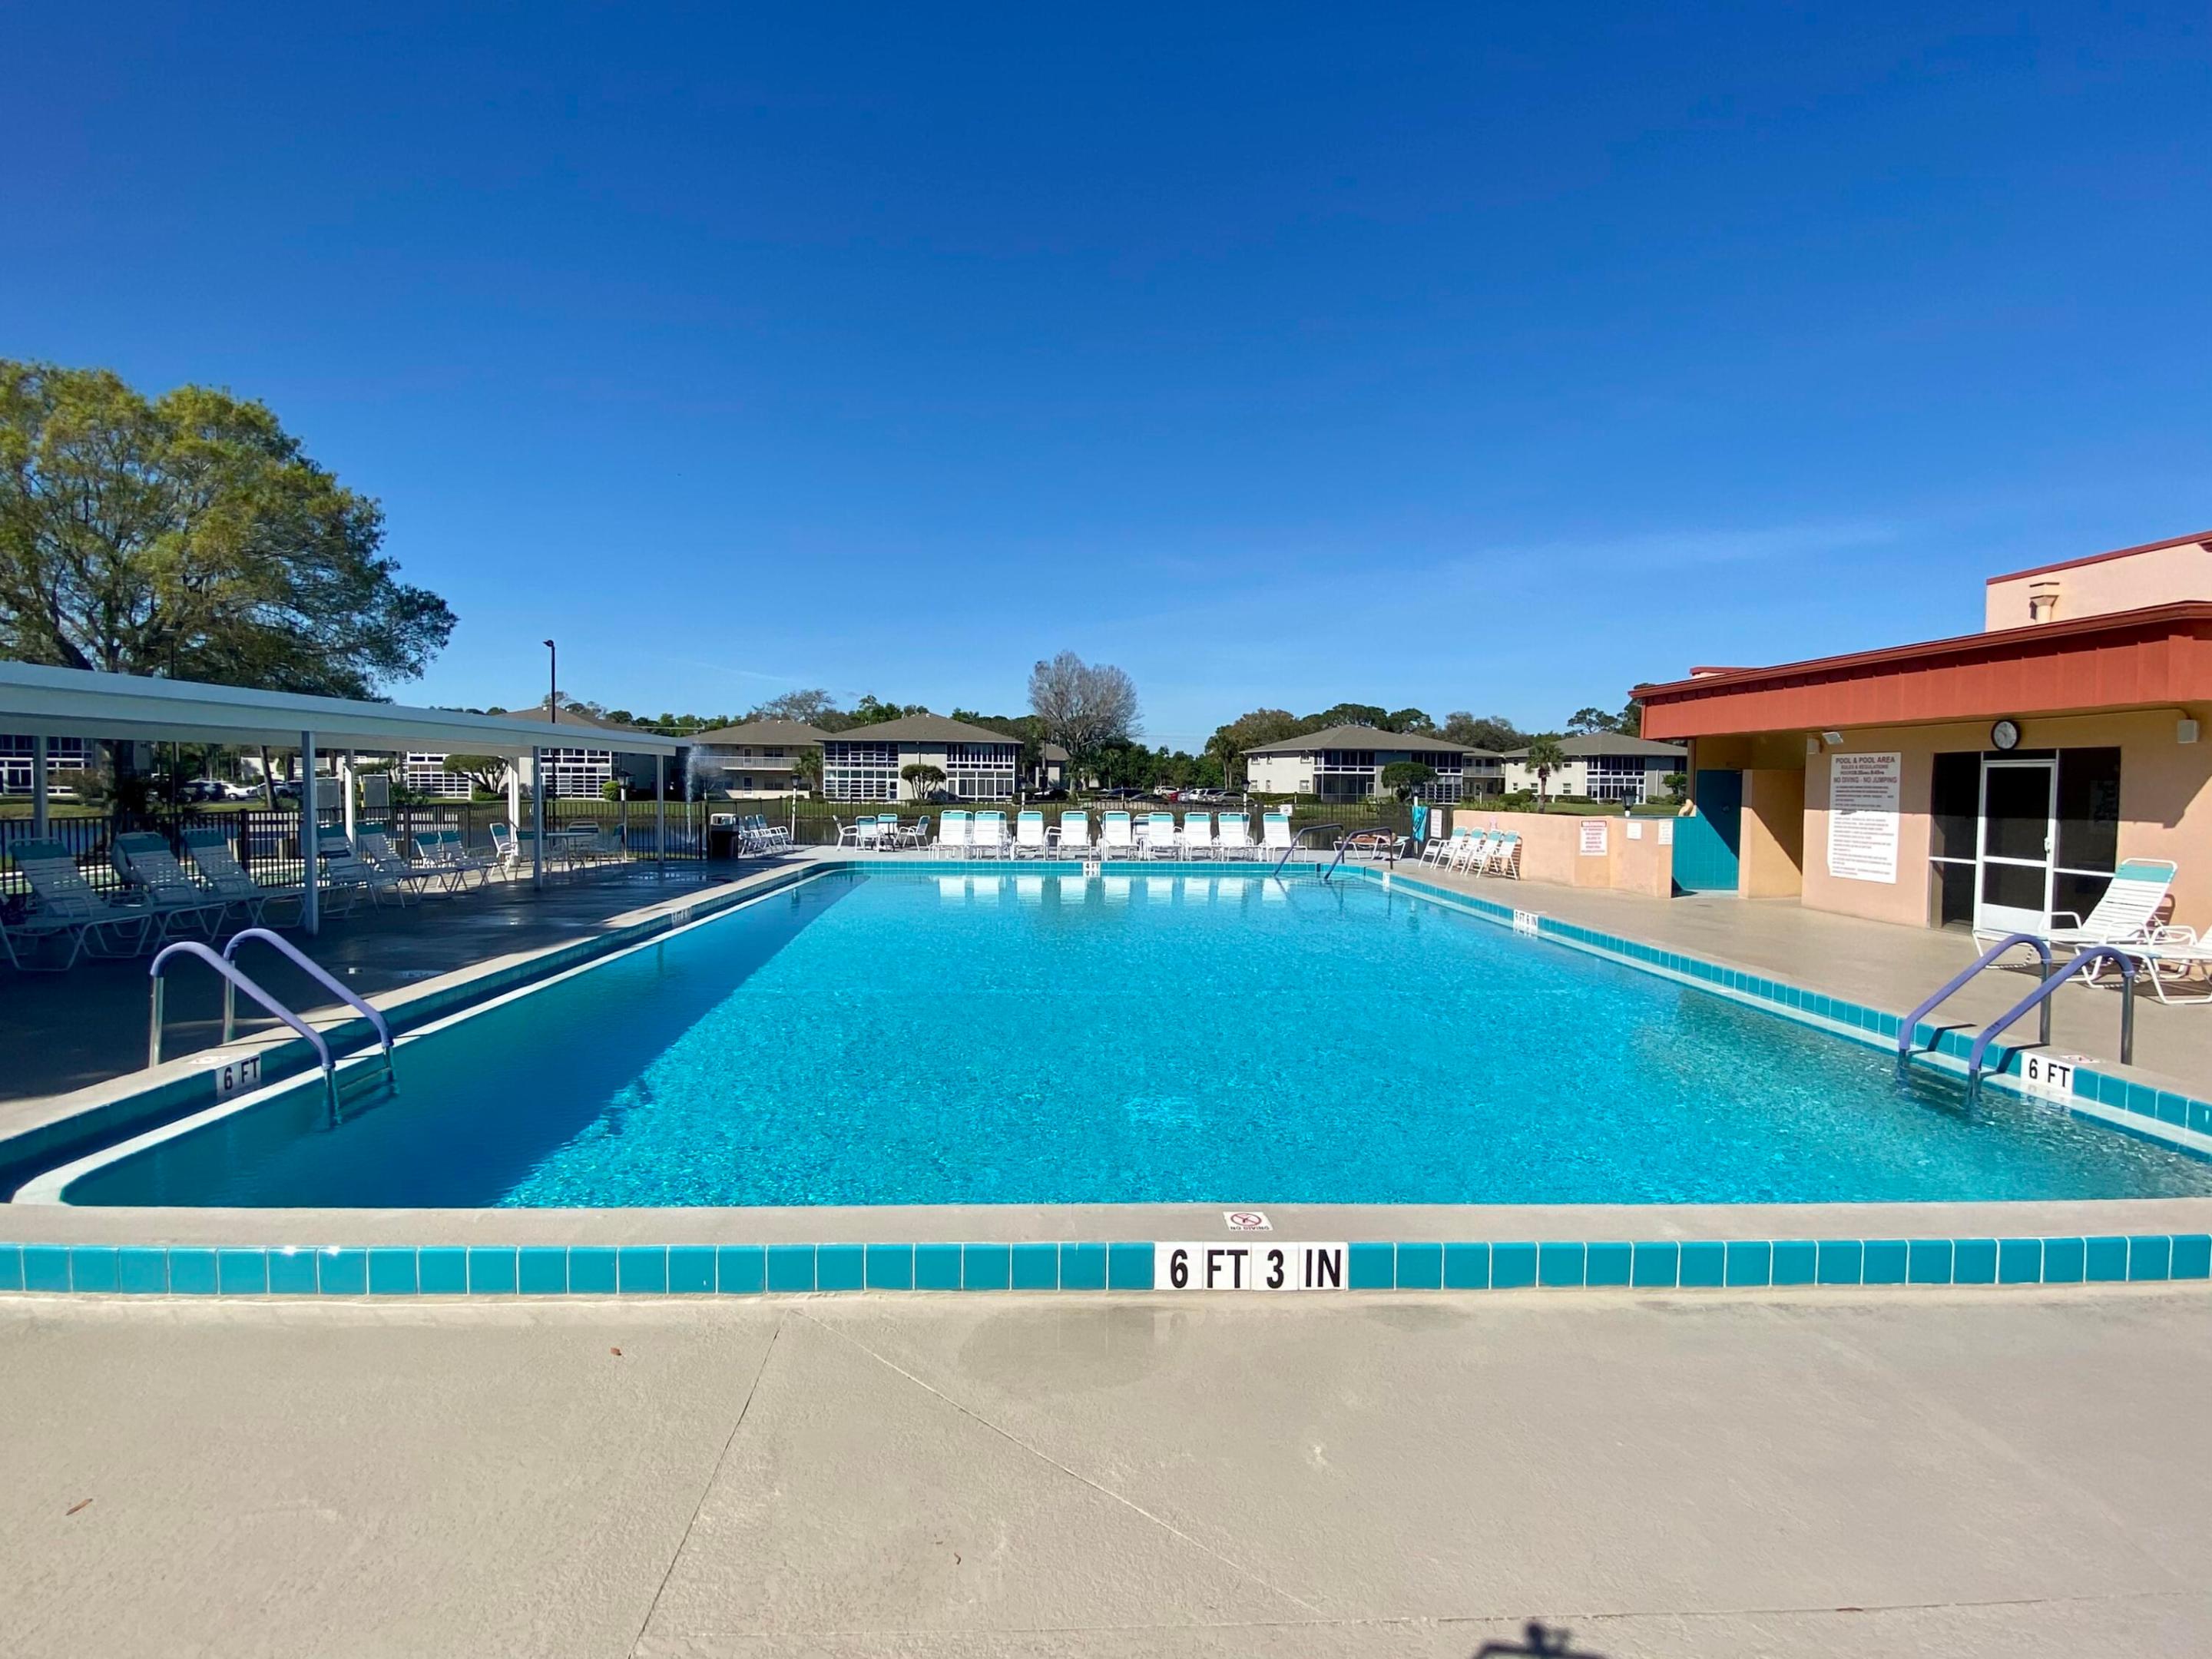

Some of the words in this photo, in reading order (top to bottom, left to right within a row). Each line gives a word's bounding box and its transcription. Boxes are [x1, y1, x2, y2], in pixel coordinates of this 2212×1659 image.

[224, 1067, 233, 1090] 6
[240, 1057, 260, 1084] FT
[2028, 1058, 2038, 1080] 6
[2048, 1062, 2071, 1088] FT
[1171, 1248, 1188, 1289] 6
[1207, 1249, 1248, 1289] FT
[1266, 1248, 1284, 1289] 3
[1305, 1249, 1341, 1288] IN
